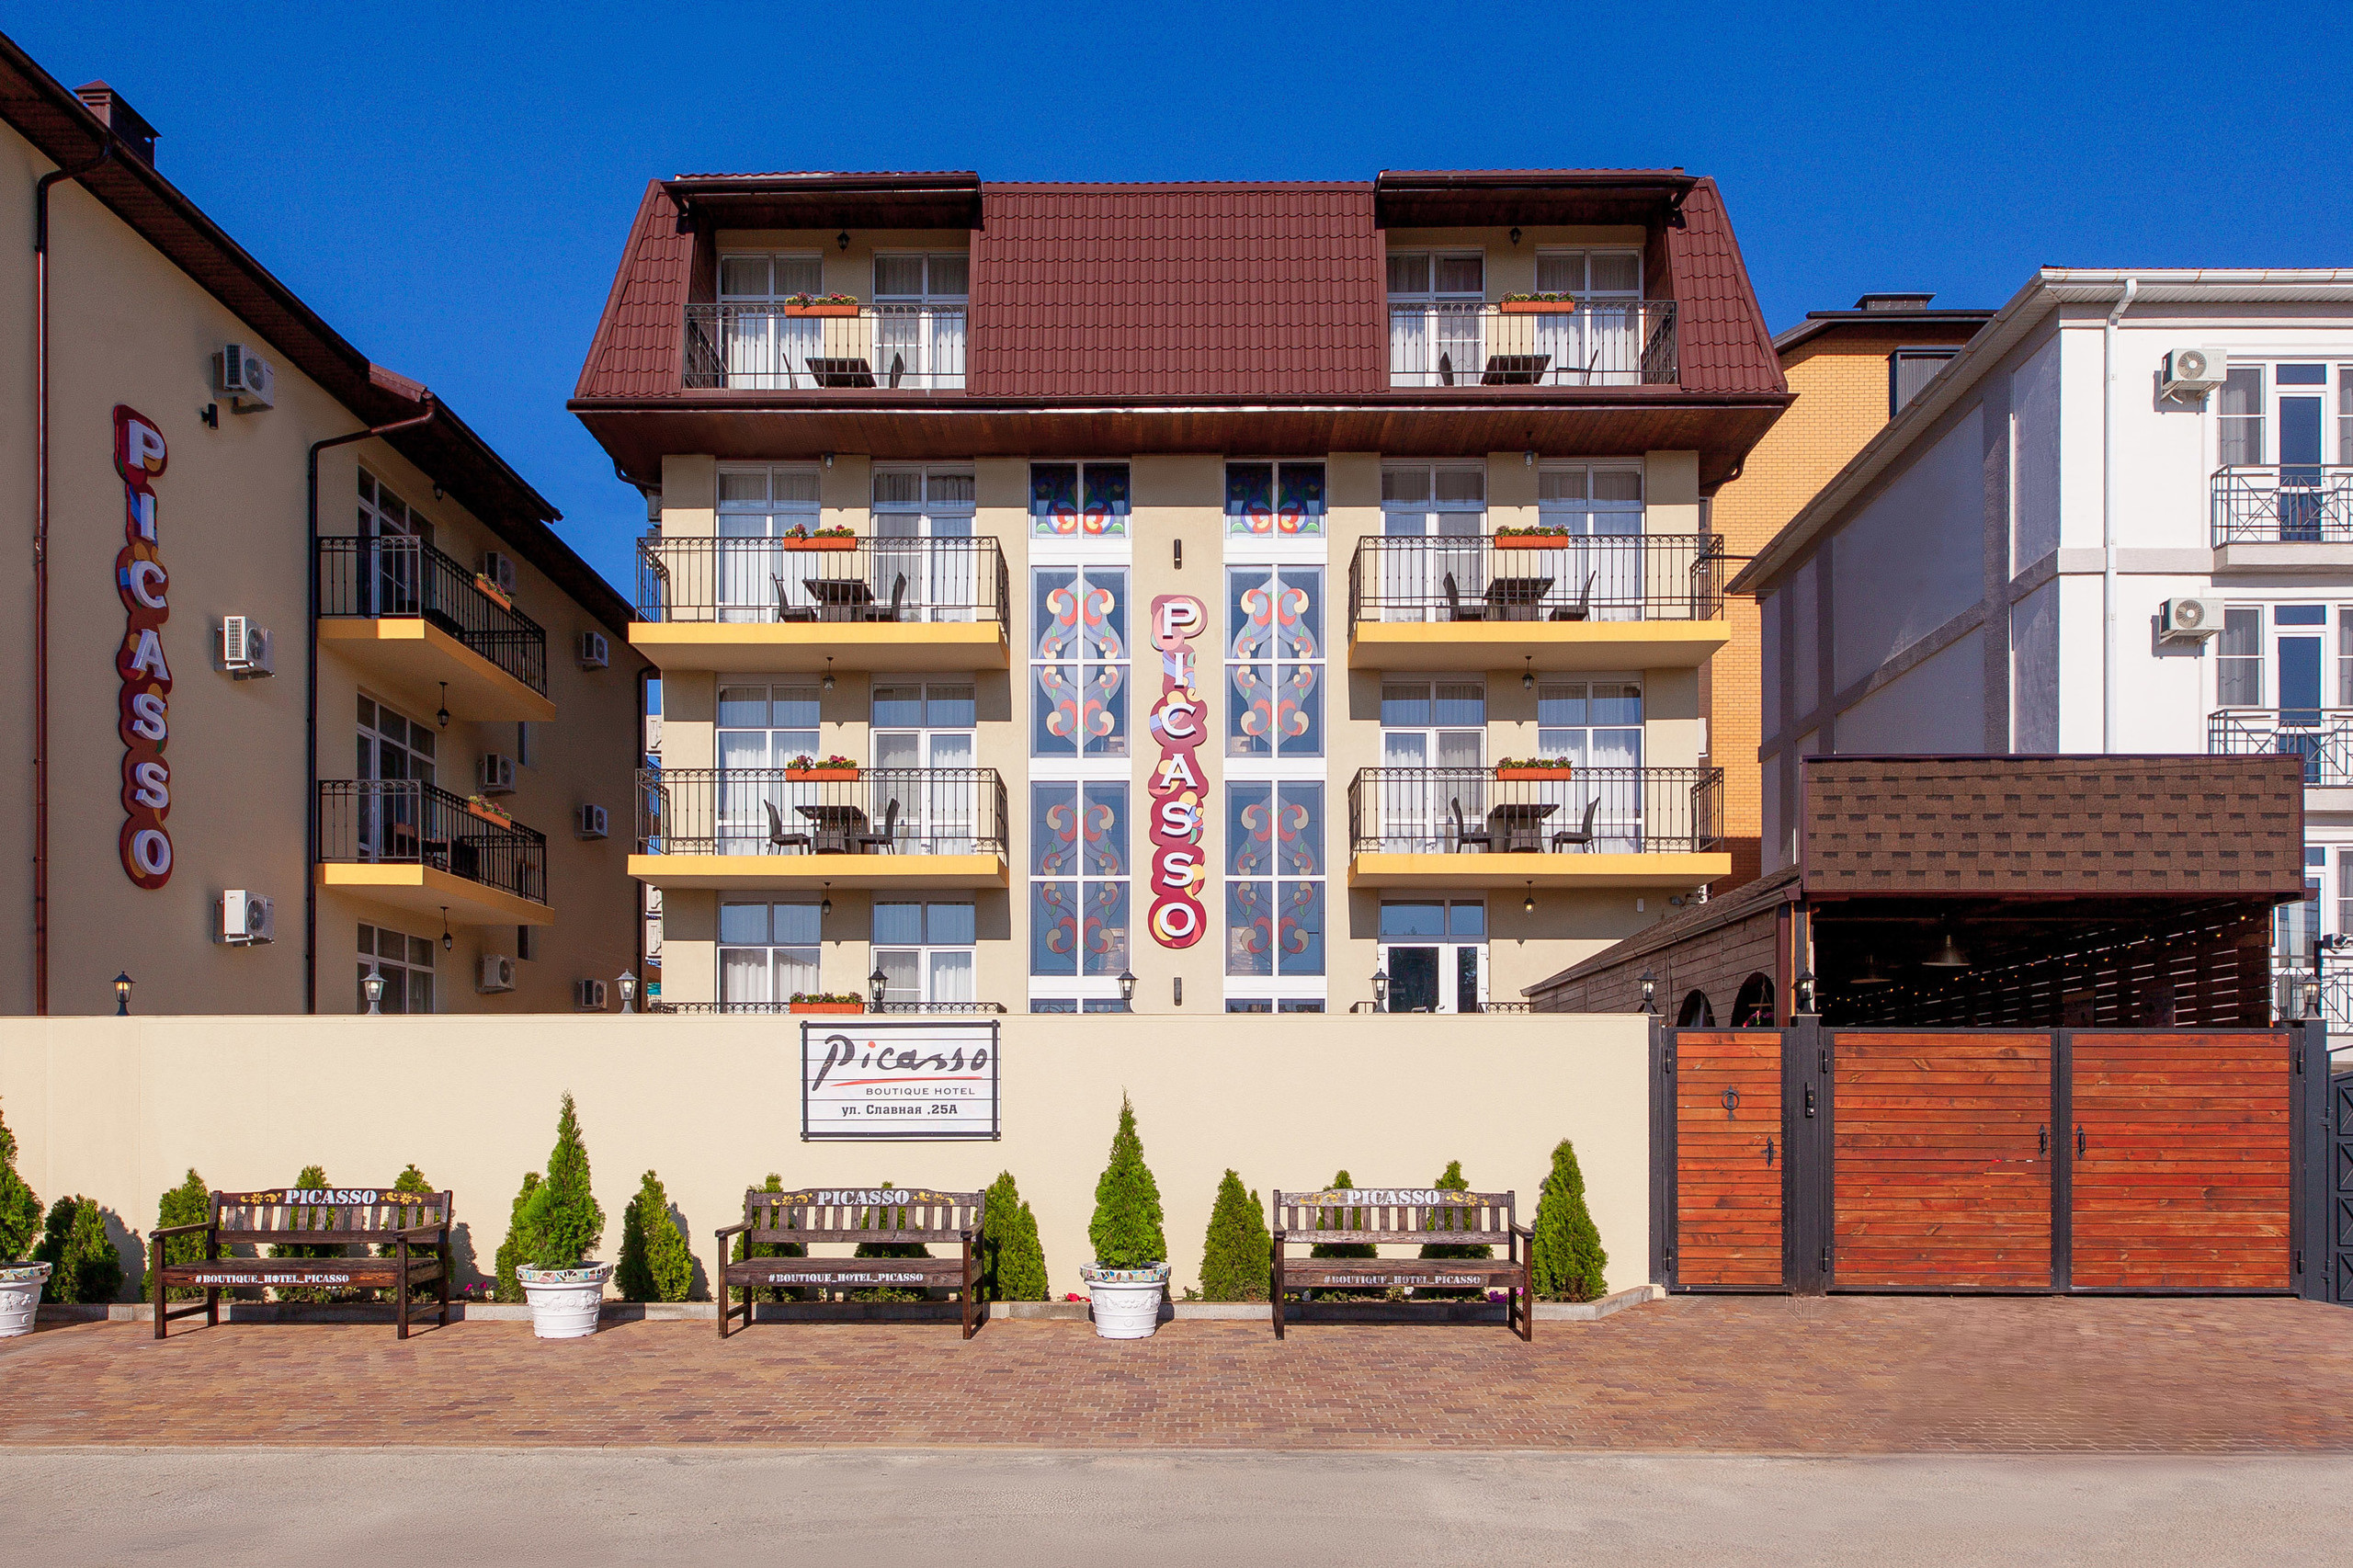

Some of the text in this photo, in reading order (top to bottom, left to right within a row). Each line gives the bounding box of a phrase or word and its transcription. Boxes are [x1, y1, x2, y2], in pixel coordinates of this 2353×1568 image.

[127, 418, 171, 876] PICASSO
[1159, 602, 1198, 938] PICASSO
[812, 1034, 988, 1092] Picasso
[866, 1087, 976, 1096] BOUTIQUE HOTEL
[841, 1105, 861, 1117] ул.
[866, 1104, 922, 1115] Славная
[284, 1189, 378, 1205] PICASSO
[816, 1189, 910, 1206] PICASSO
[1346, 1189, 1440, 1206] PICASSO
